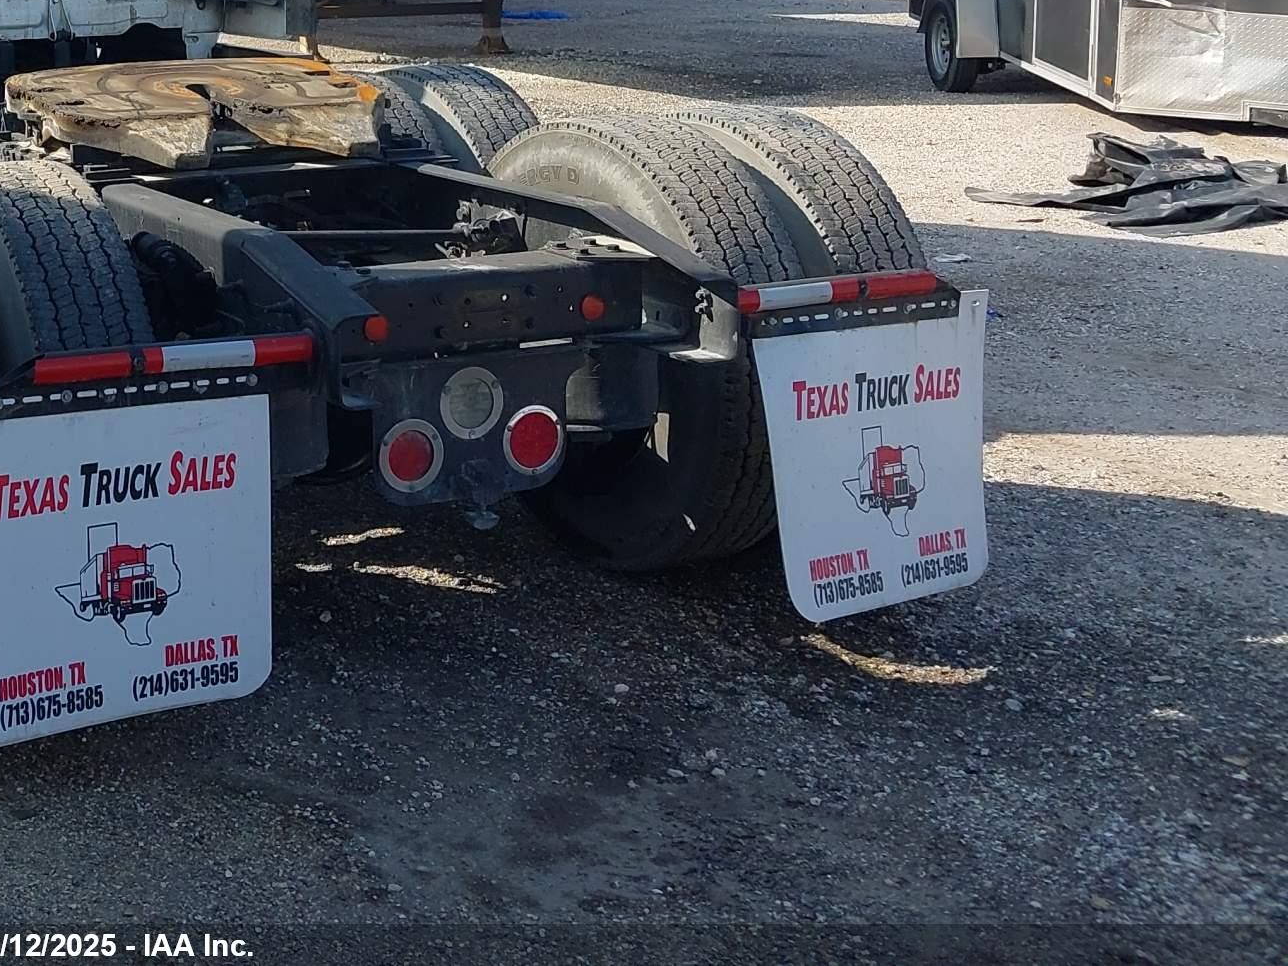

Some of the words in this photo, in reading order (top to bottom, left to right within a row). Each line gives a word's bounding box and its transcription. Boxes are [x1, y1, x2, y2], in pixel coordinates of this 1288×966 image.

[792, 380, 849, 422] TEXAS
[854, 371, 910, 413] TRUCK
[913, 363, 962, 405] SALES
[79, 461, 162, 509] TRUCK
[166, 450, 238, 497] SALES
[918, 531, 954, 558] DALLAS,
[954, 527, 967, 550] TX
[808, 553, 857, 582] HOUSTON,
[856, 548, 869, 570] TX
[900, 551, 969, 589] (214)631-9595
[812, 570, 885, 609] (713)675-8585
[164, 640, 220, 668] DALLAS,
[220, 634, 240, 659] TX
[68, 661, 87, 687] TX
[132, 661, 240, 704] (214)631-9595
[0, 683, 105, 732] (713)675-8585
